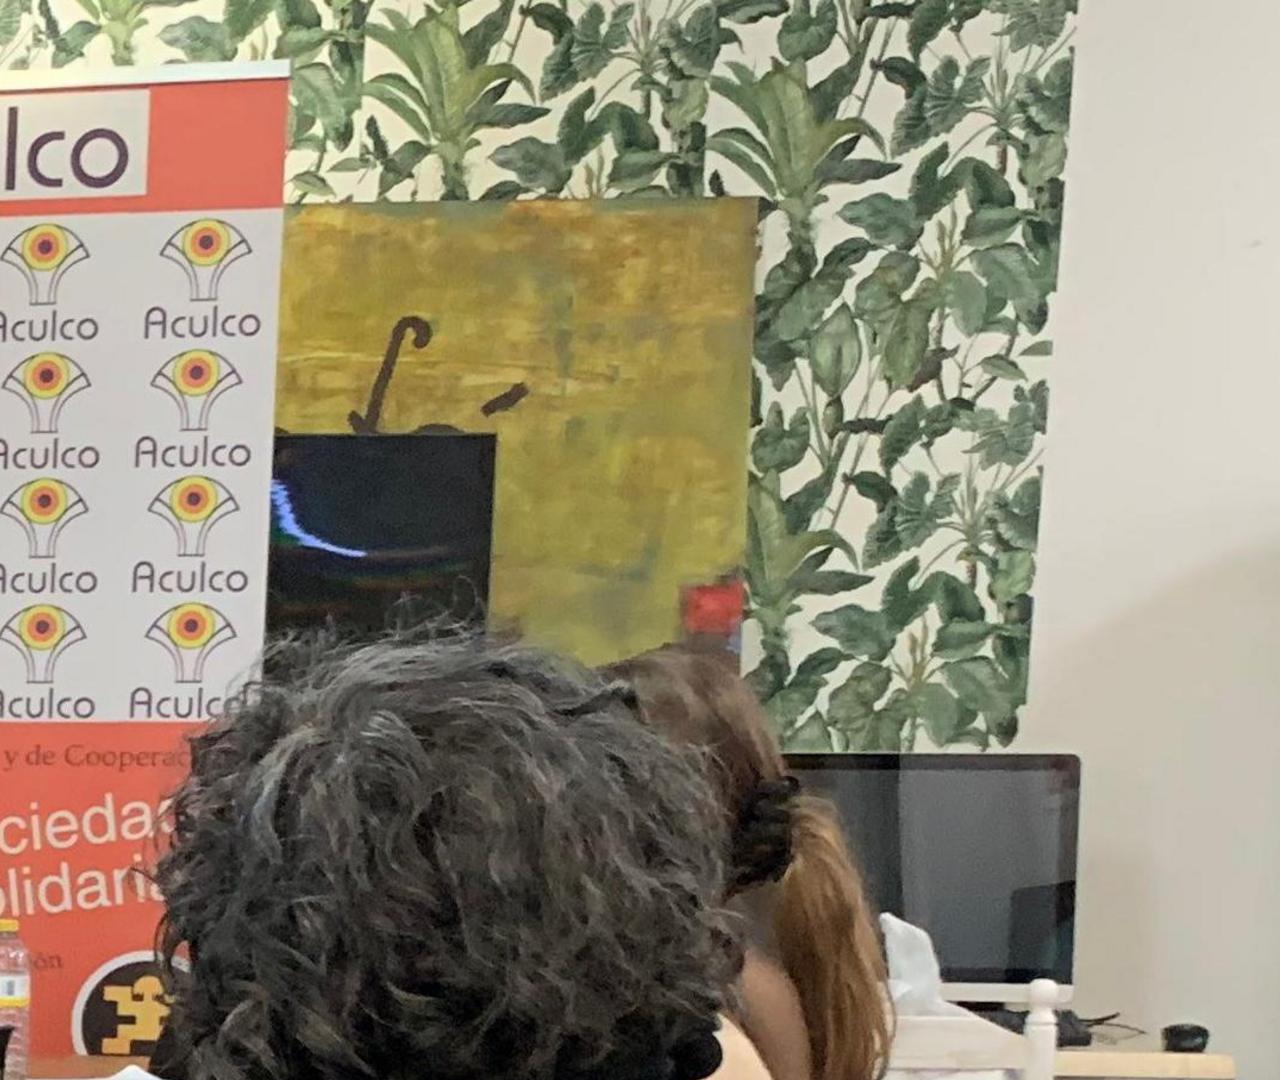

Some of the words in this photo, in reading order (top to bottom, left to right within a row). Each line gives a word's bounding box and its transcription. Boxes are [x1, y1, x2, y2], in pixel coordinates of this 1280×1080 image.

[144, 306, 261, 339] Aculco
[135, 436, 252, 467] Aculco
[132, 561, 248, 592] Aculco
[3, 751, 20, 771] y
[26, 744, 56, 767] de
